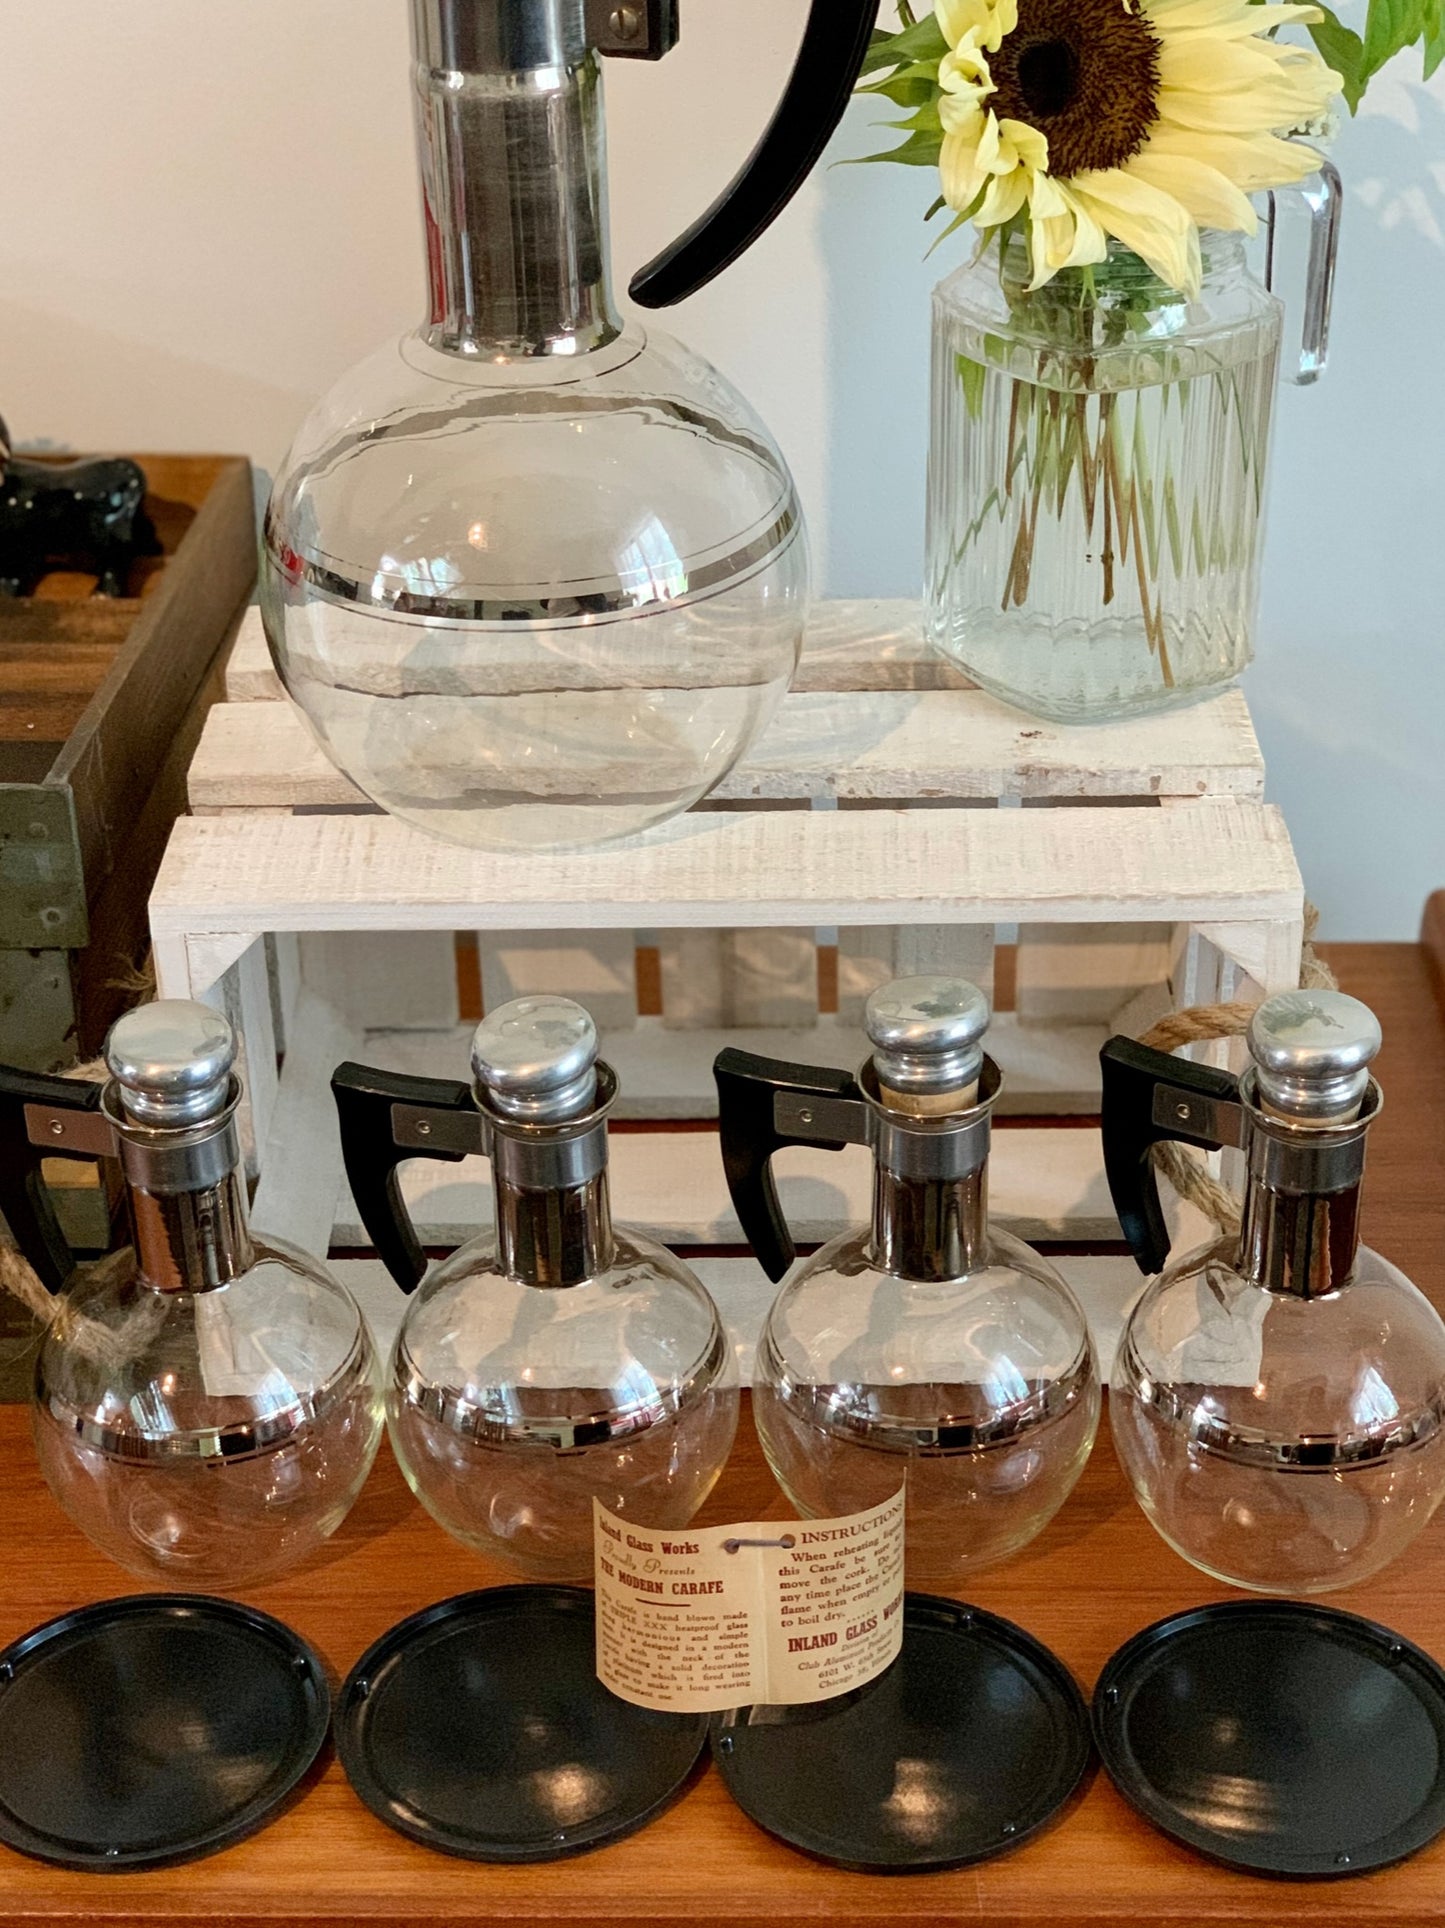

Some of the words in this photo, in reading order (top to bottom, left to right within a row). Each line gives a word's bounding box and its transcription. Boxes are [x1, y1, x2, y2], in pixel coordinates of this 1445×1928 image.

[599, 1516, 621, 1541] Inland
[627, 1535, 653, 1553] Glass
[661, 1542, 699, 1554] Works
[791, 1553, 826, 1562] When
[834, 1538, 879, 1557] reheating
[644, 1559, 695, 1575] Presents
[779, 1567, 799, 1576] this
[810, 1561, 846, 1573] Carafe
[855, 1556, 865, 1564] be
[874, 1544, 889, 1556] sure
[600, 1557, 614, 1577] THE
[619, 1570, 663, 1594] MODERN
[672, 1581, 723, 1595] CARAFE
[780, 1579, 810, 1589] move
[820, 1576, 837, 1585] the
[845, 1566, 870, 1579] cork.
[878, 1555, 889, 1566] Do
[780, 1593, 801, 1602] any
[806, 1591, 830, 1599] time
[836, 1582, 861, 1596] place
[865, 1573, 878, 1585] the
[781, 1606, 811, 1615] flame
[818, 1600, 846, 1610] when
[852, 1585, 880, 1601] empty
[611, 1607, 636, 1624] TRIPLE
[644, 1622, 667, 1630] XXX
[676, 1622, 719, 1631] heatproof
[798, 1615, 819, 1625] boil
[824, 1612, 845, 1622] dry.
[622, 1624, 680, 1641] harmonious
[719, 1632, 748, 1640] simple
[788, 1632, 837, 1652] INLAND
[846, 1616, 877, 1640] GLASS
[631, 1648, 647, 1656] with
[642, 1640, 679, 1651] designed
[625, 1655, 650, 1668] having
[702, 1662, 749, 1671] decoration
[798, 1661, 819, 1671] Club
[651, 1672, 677, 1680] which
[819, 1674, 853, 1689] Chicago
[648, 1682, 669, 1690] make
[716, 1680, 750, 1689] wearing
